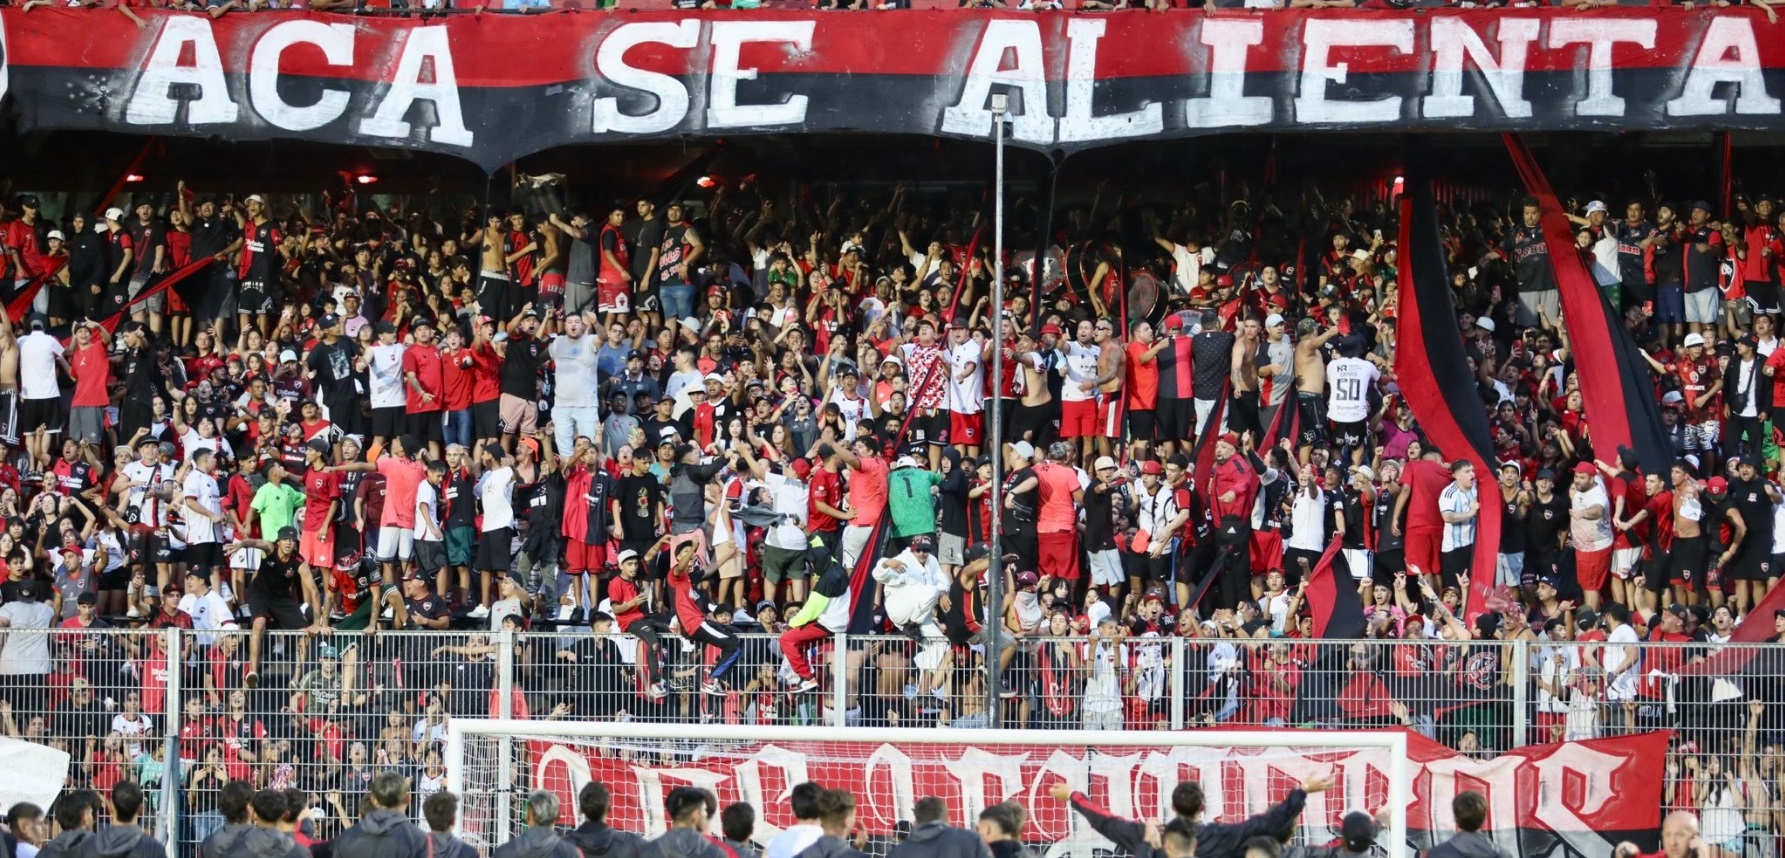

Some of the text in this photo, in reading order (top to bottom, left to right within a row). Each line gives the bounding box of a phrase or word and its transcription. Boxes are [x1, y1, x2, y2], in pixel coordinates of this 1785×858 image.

[126, 15, 1781, 147] ACA SE ALIENTA
[1336, 378, 1361, 401] 50
[902, 477, 914, 499] 1
